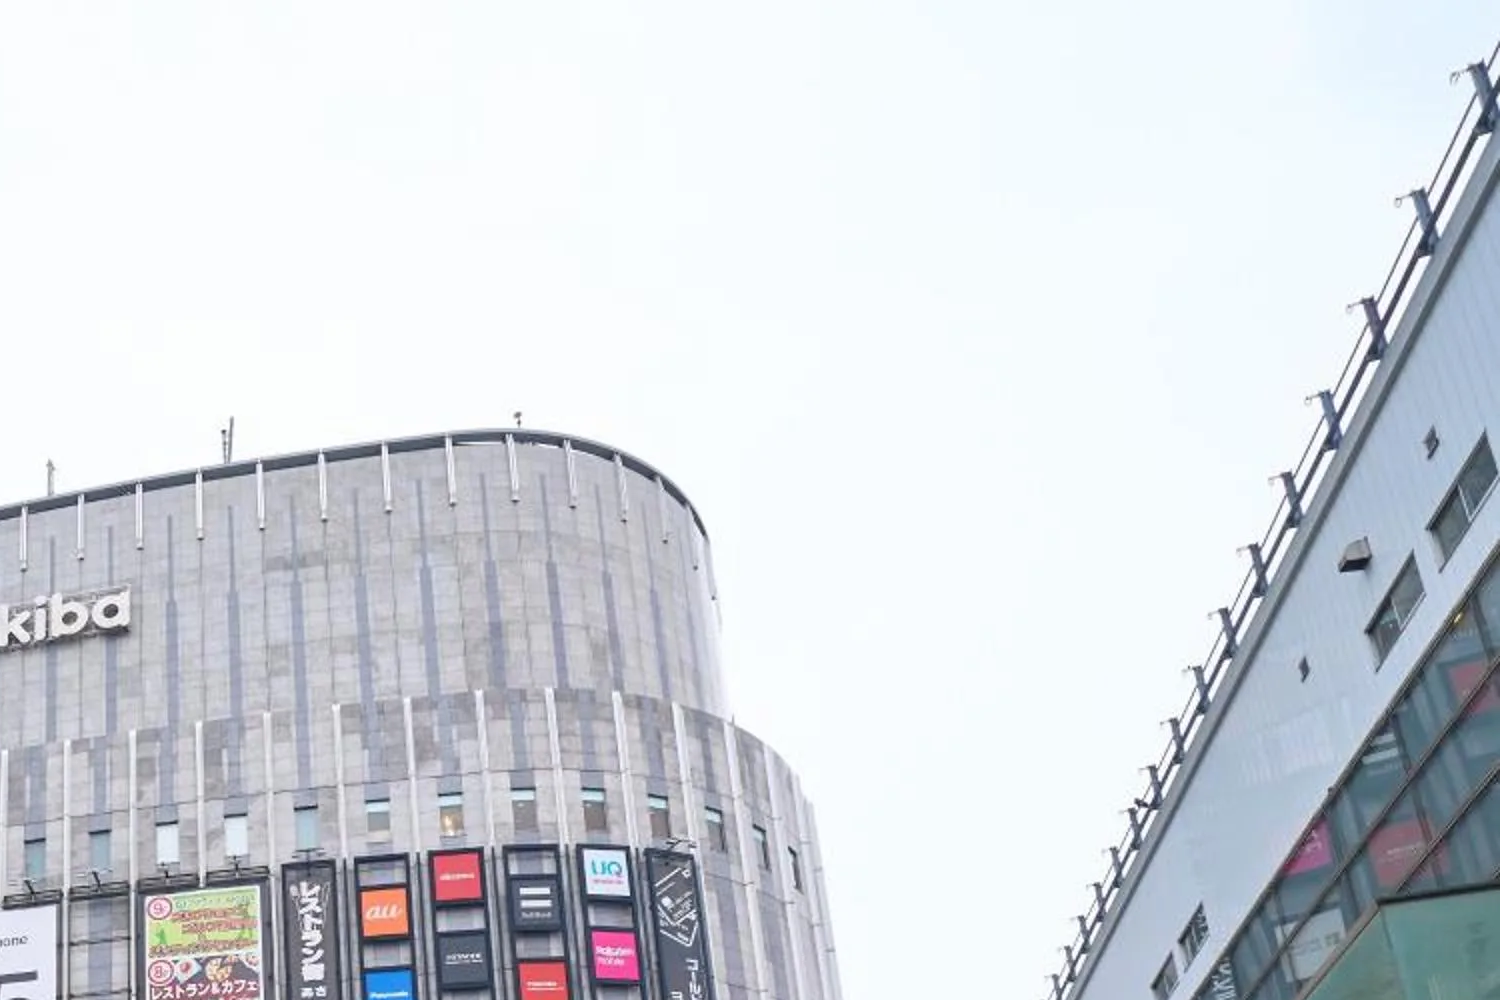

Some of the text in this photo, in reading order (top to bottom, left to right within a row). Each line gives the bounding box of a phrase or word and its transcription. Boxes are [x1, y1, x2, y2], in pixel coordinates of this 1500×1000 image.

[592, 860, 622, 876] UQ
[366, 904, 402, 920] au
[301, 985, 327, 998] あさ
